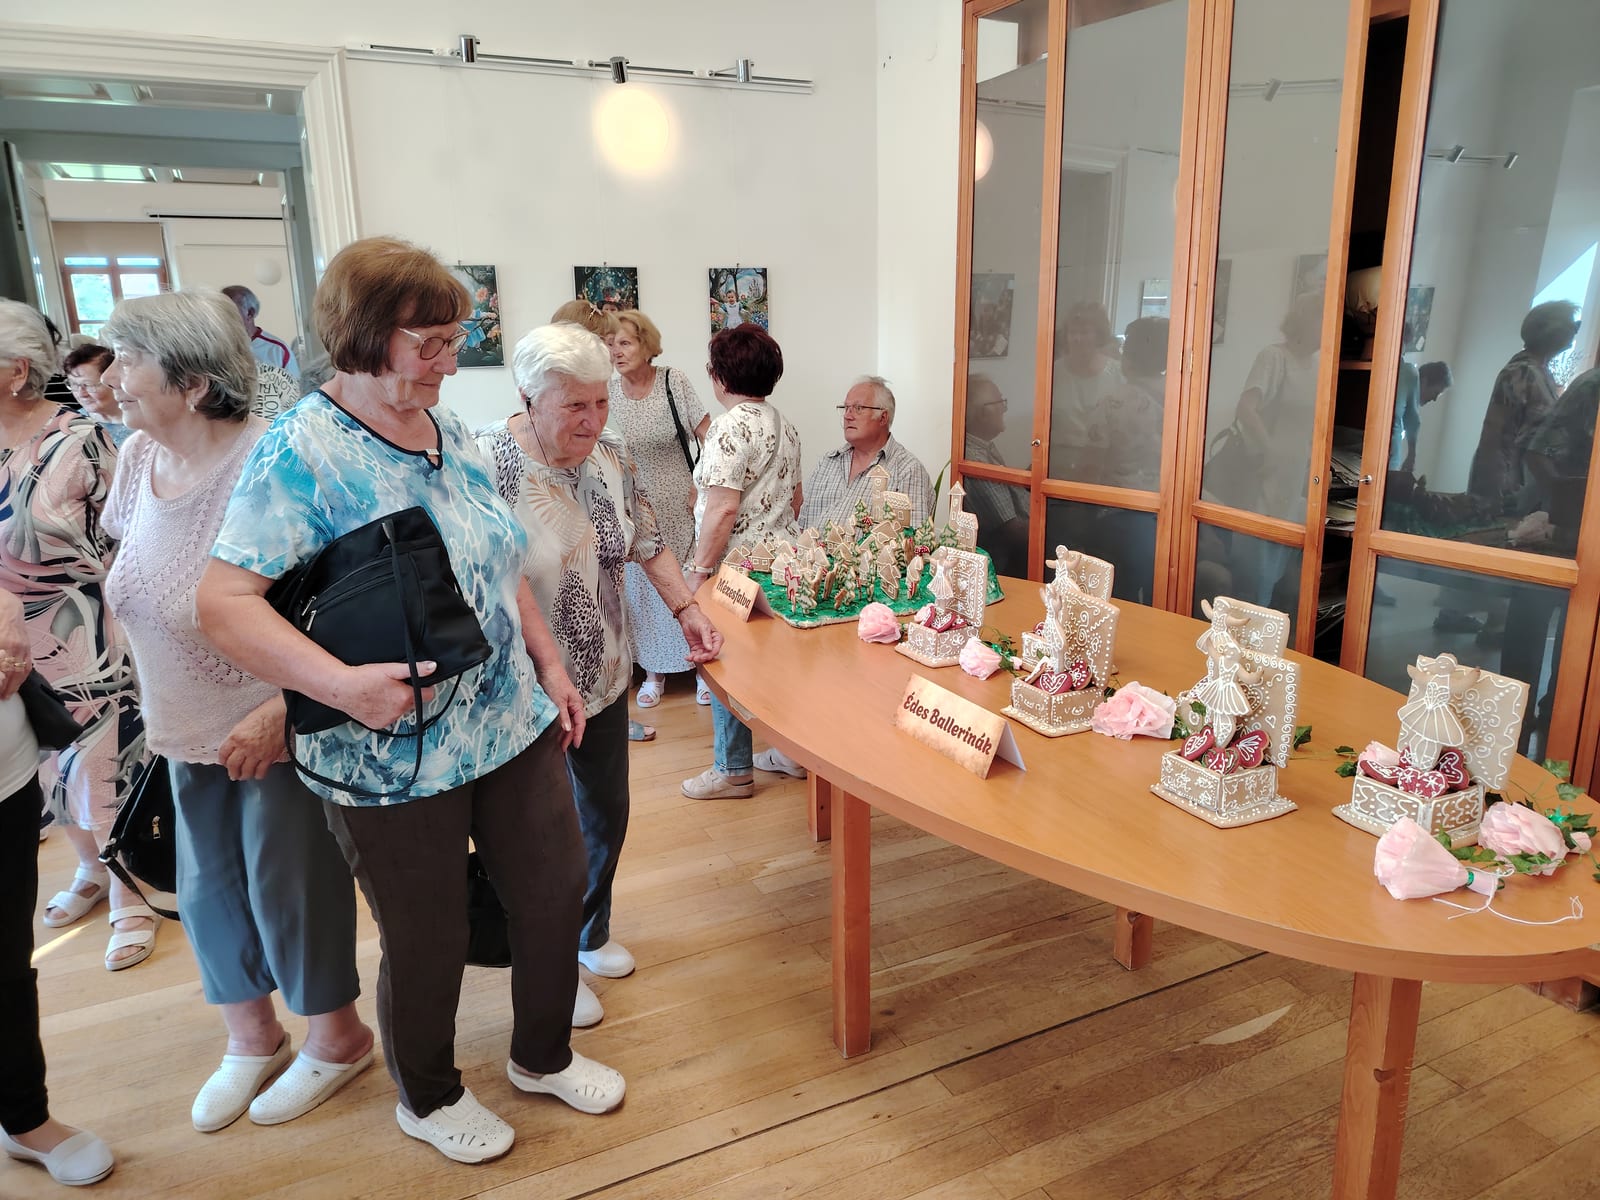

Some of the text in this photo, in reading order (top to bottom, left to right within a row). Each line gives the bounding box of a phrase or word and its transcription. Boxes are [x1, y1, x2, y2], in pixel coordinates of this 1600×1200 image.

[716, 578, 751, 609] Mézesfalva
[903, 692, 992, 755] Édes Ballerinák
